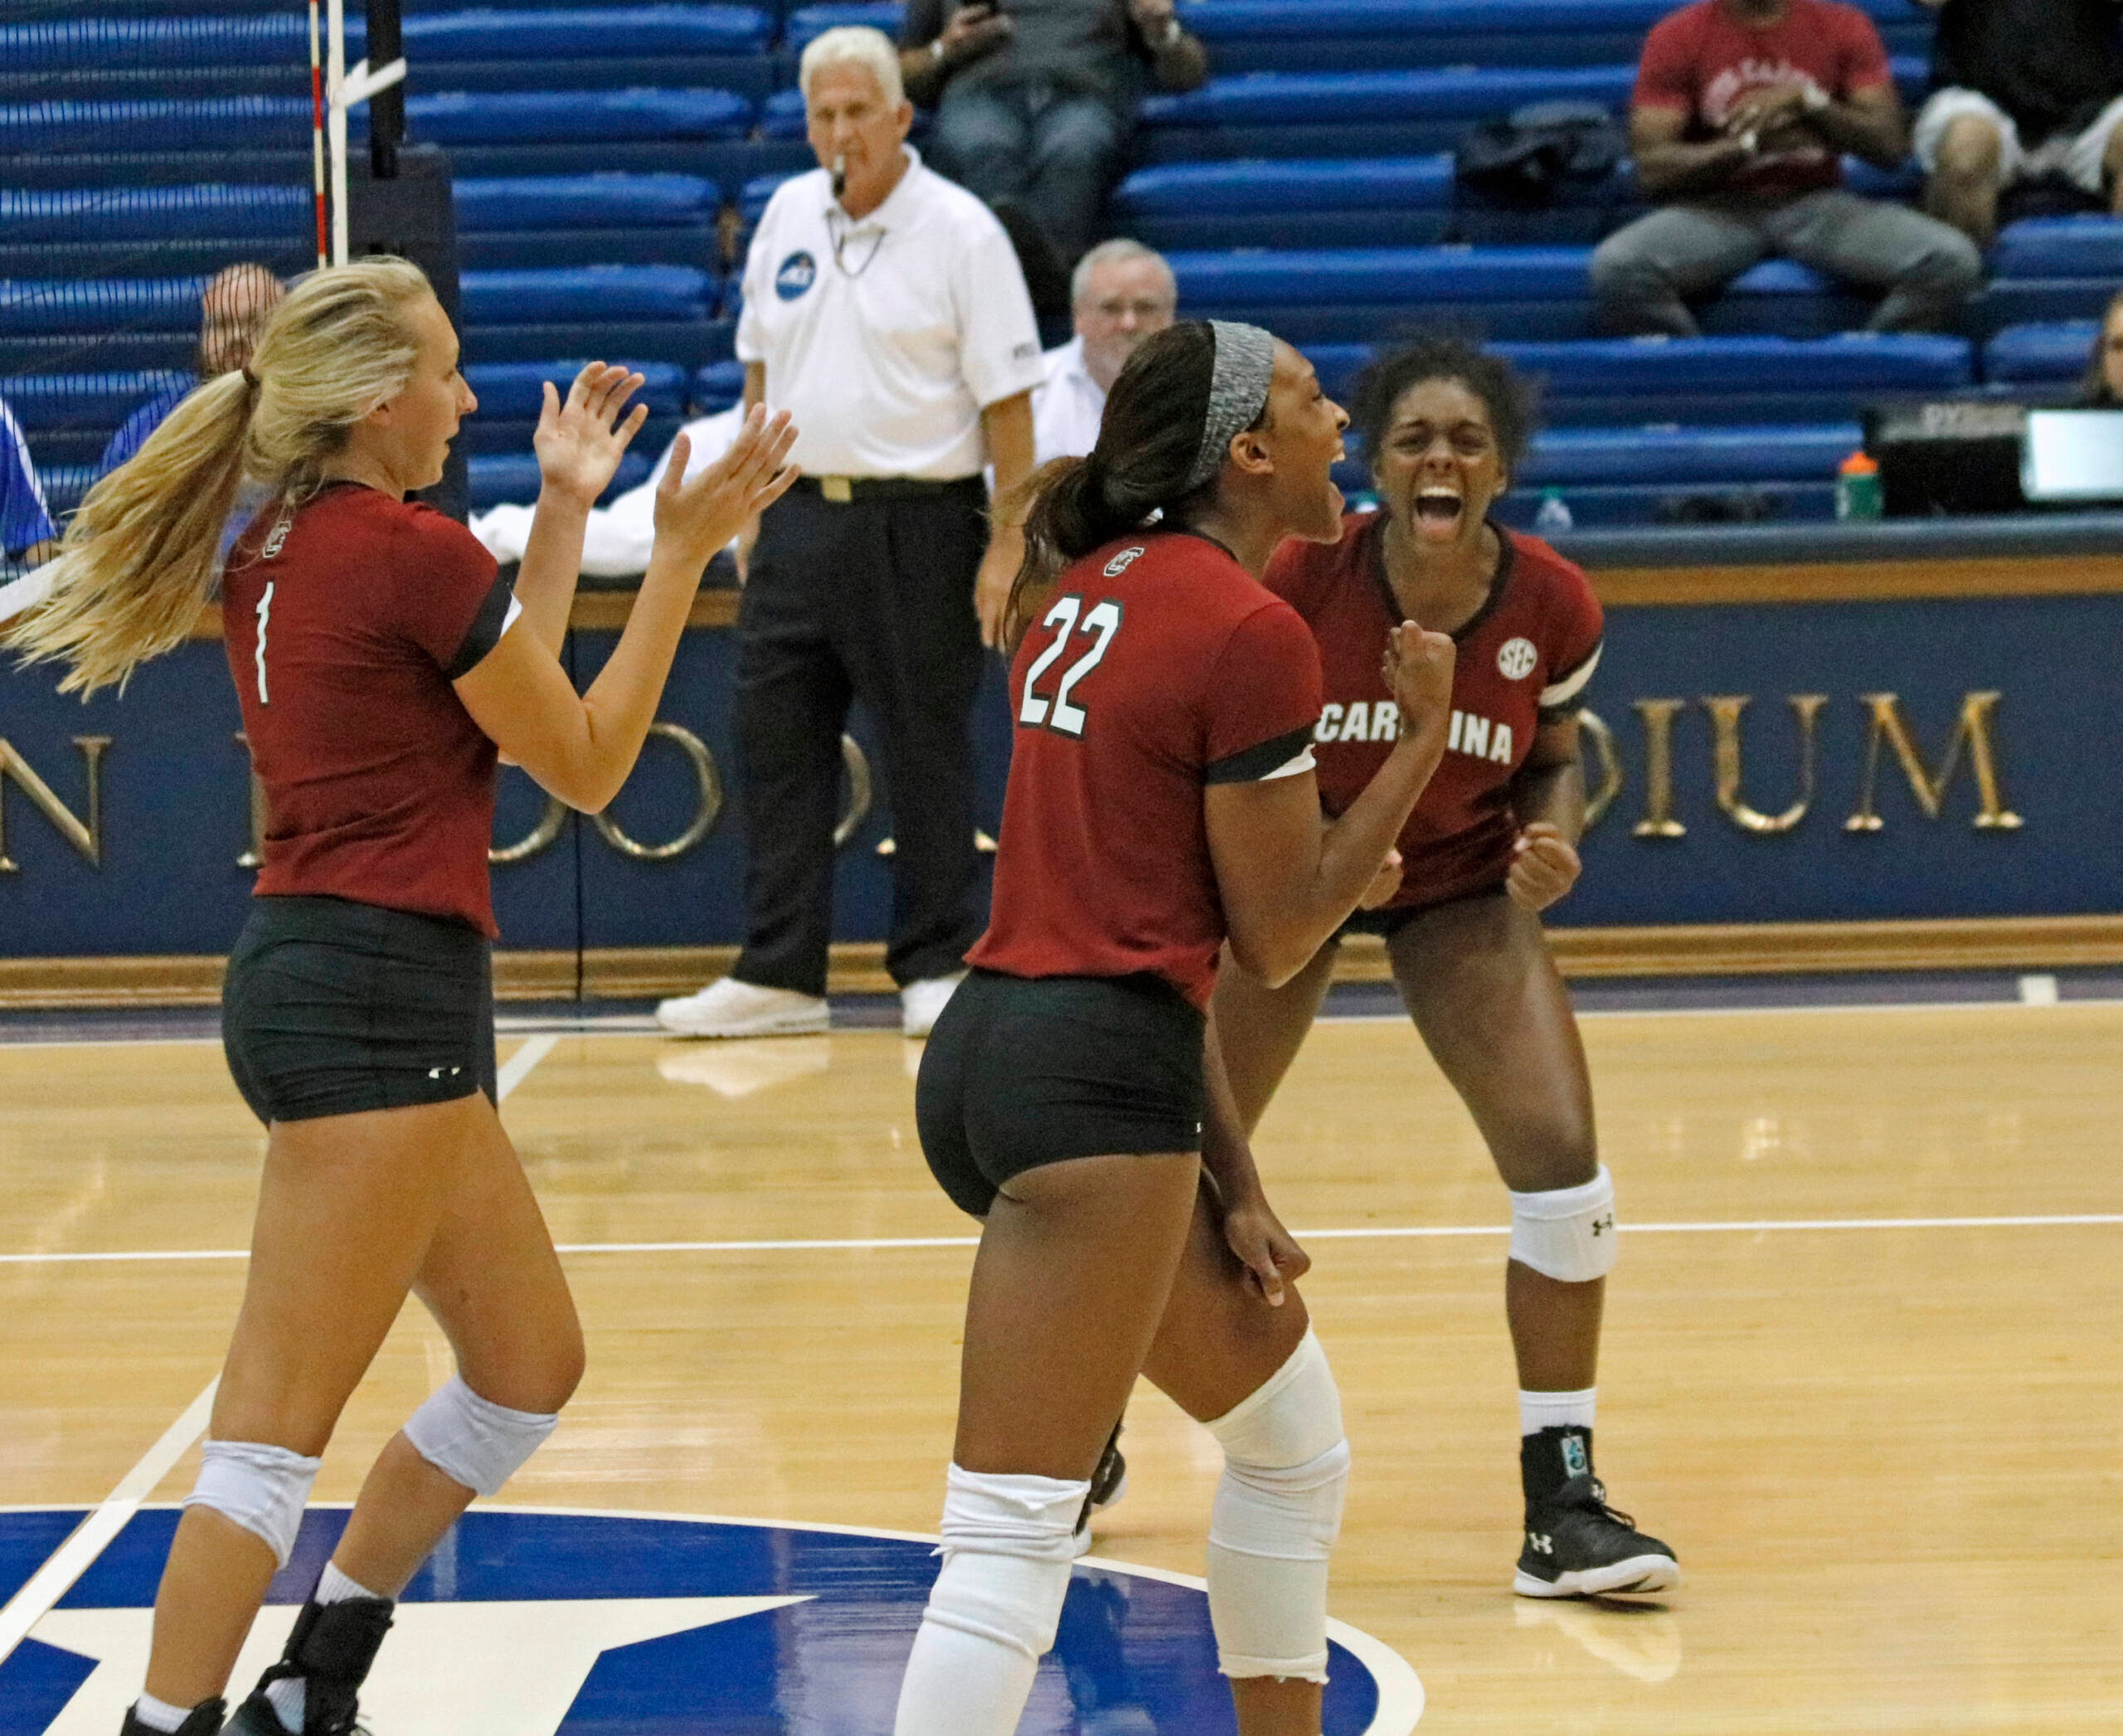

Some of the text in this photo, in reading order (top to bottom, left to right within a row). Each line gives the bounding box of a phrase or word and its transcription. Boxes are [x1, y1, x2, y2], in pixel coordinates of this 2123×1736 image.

[255, 580, 275, 705] 1
[1019, 593, 1123, 739] 22
[1498, 638, 1537, 679] SEC
[1314, 701, 1513, 764] CARINA
